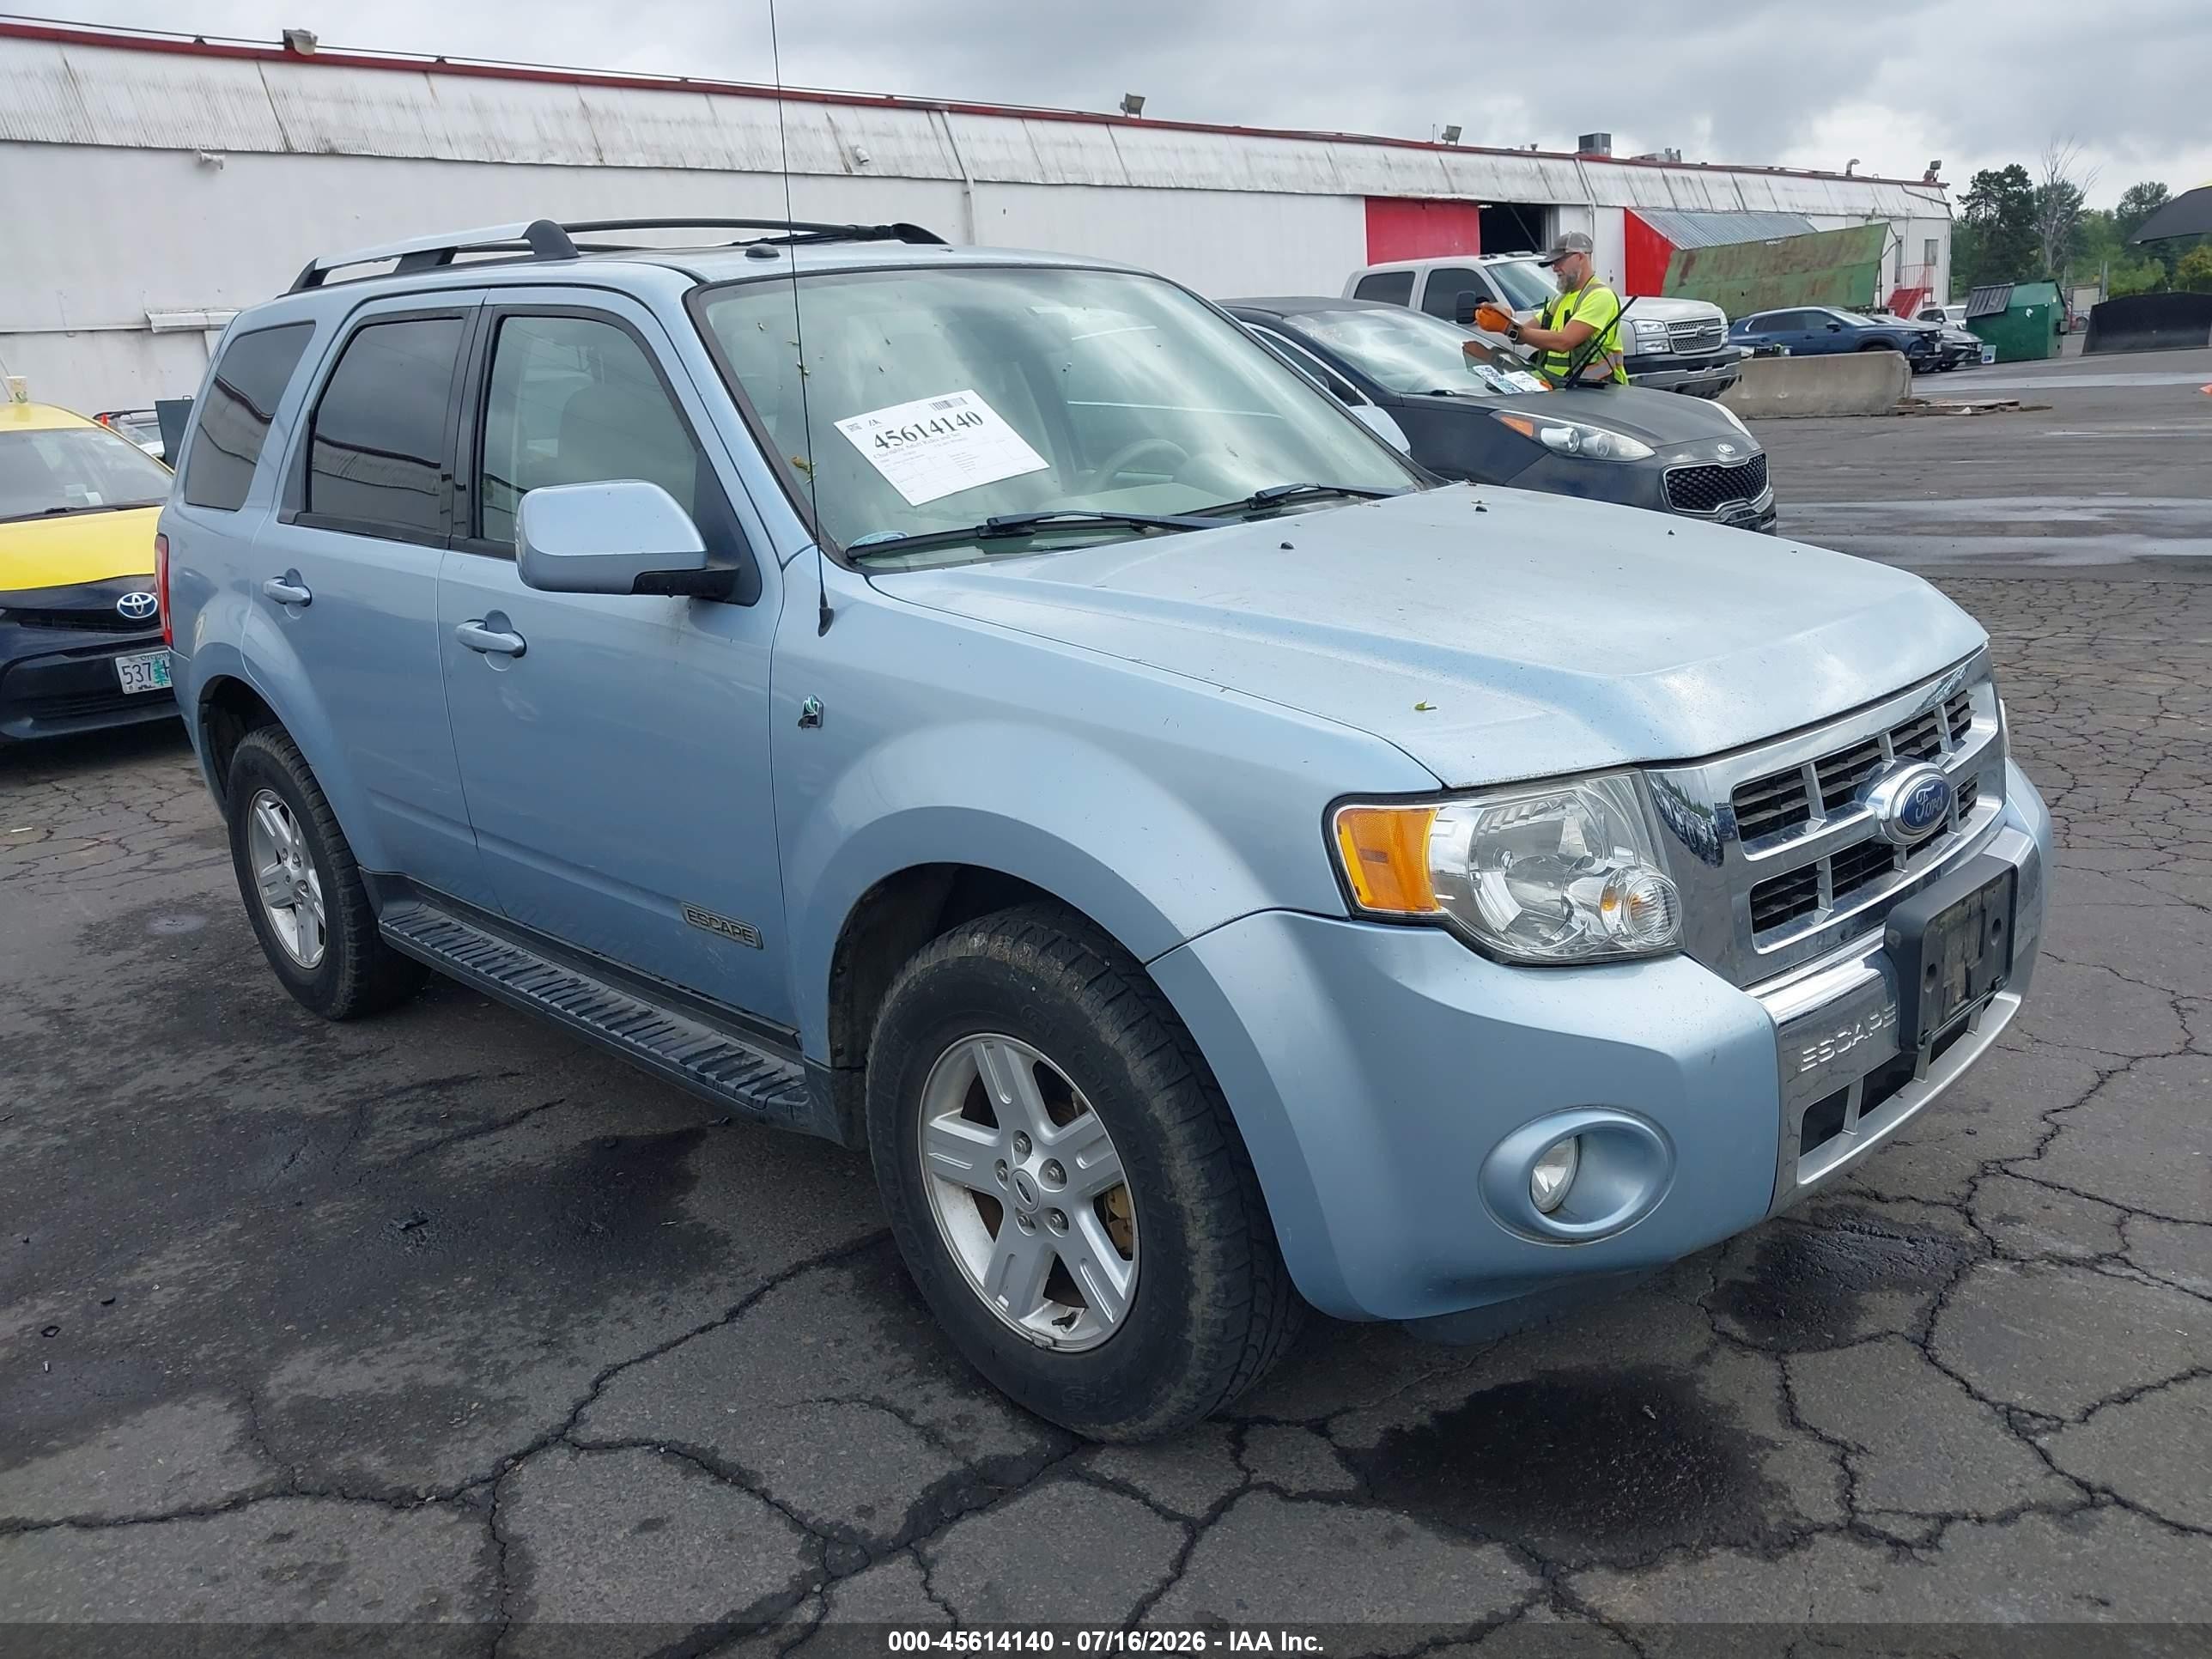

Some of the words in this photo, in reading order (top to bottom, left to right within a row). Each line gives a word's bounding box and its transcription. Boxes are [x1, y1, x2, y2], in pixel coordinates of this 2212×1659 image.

[874, 410, 983, 448] 45614140
[1915, 782, 1943, 823] Ford
[686, 908, 756, 944] ESCAPE
[1801, 1002, 1897, 1073] ESCAPE
